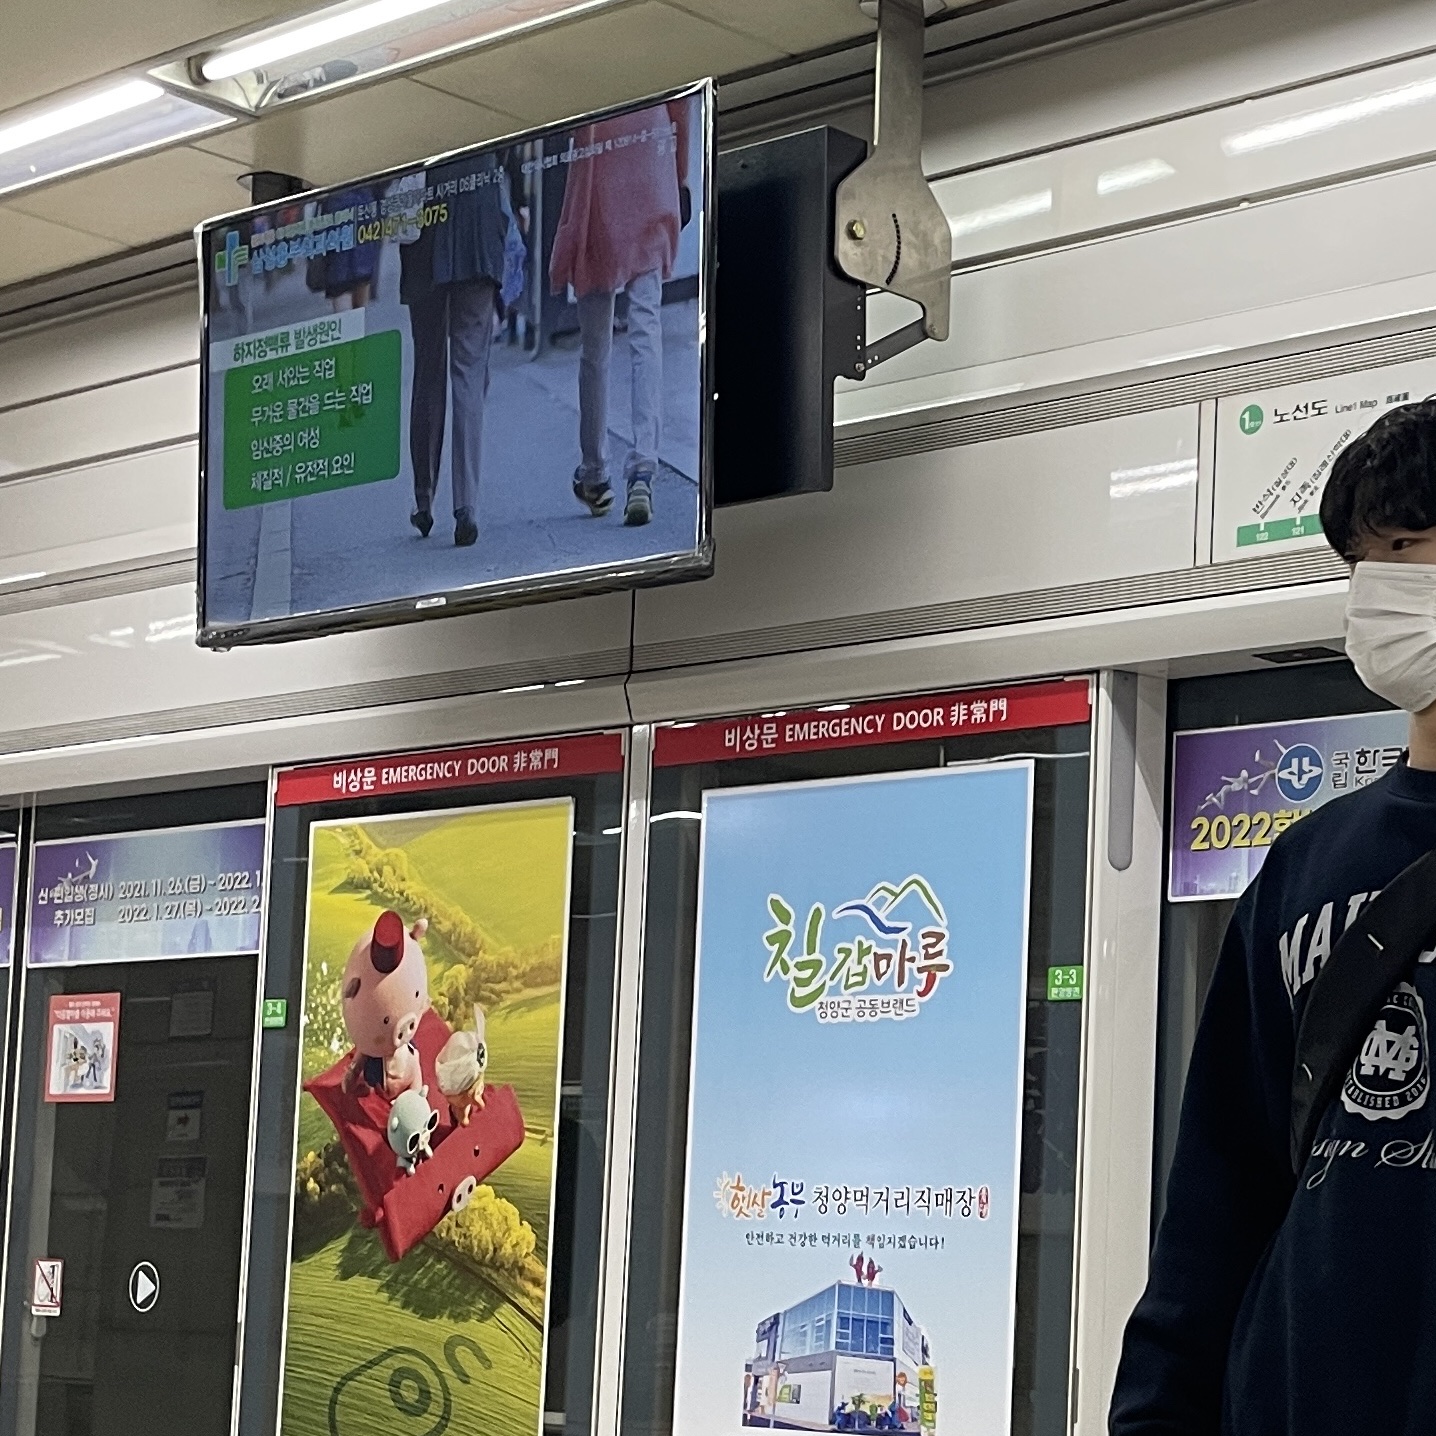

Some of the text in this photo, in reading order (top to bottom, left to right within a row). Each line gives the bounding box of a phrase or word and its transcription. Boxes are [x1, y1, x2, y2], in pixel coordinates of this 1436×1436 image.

[233, 318, 342, 363] 하지정맥류 발생원인
[251, 357, 336, 394] 오래 서있는 직업
[251, 381, 373, 427] 무거운 물건을 드는 직업
[1272, 399, 1328, 425] 노선도
[251, 426, 320, 460] 임신중의 여성
[251, 468, 284, 492] 체질적
[295, 458, 328, 483] 유전적
[331, 452, 355, 475] 요인
[724, 697, 1008, 753] 비상문 EMERGENCY DOOR 非常門
[332, 747, 559, 793] 비상문 EMERGENCY DOOR 非常門
[53, 907, 96, 928] 추가모집
[765, 896, 951, 1009] 칠갑마루
[1055, 969, 1077, 985] 3-3
[817, 998, 917, 1019] 청양군 공동브랜드
[812, 1185, 977, 1218] 청양먹거리직매장
[745, 1231, 785, 1246] 안전하고
[787, 1232, 818, 1247] 건강한
[821, 1233, 862, 1249] 먹거리를
